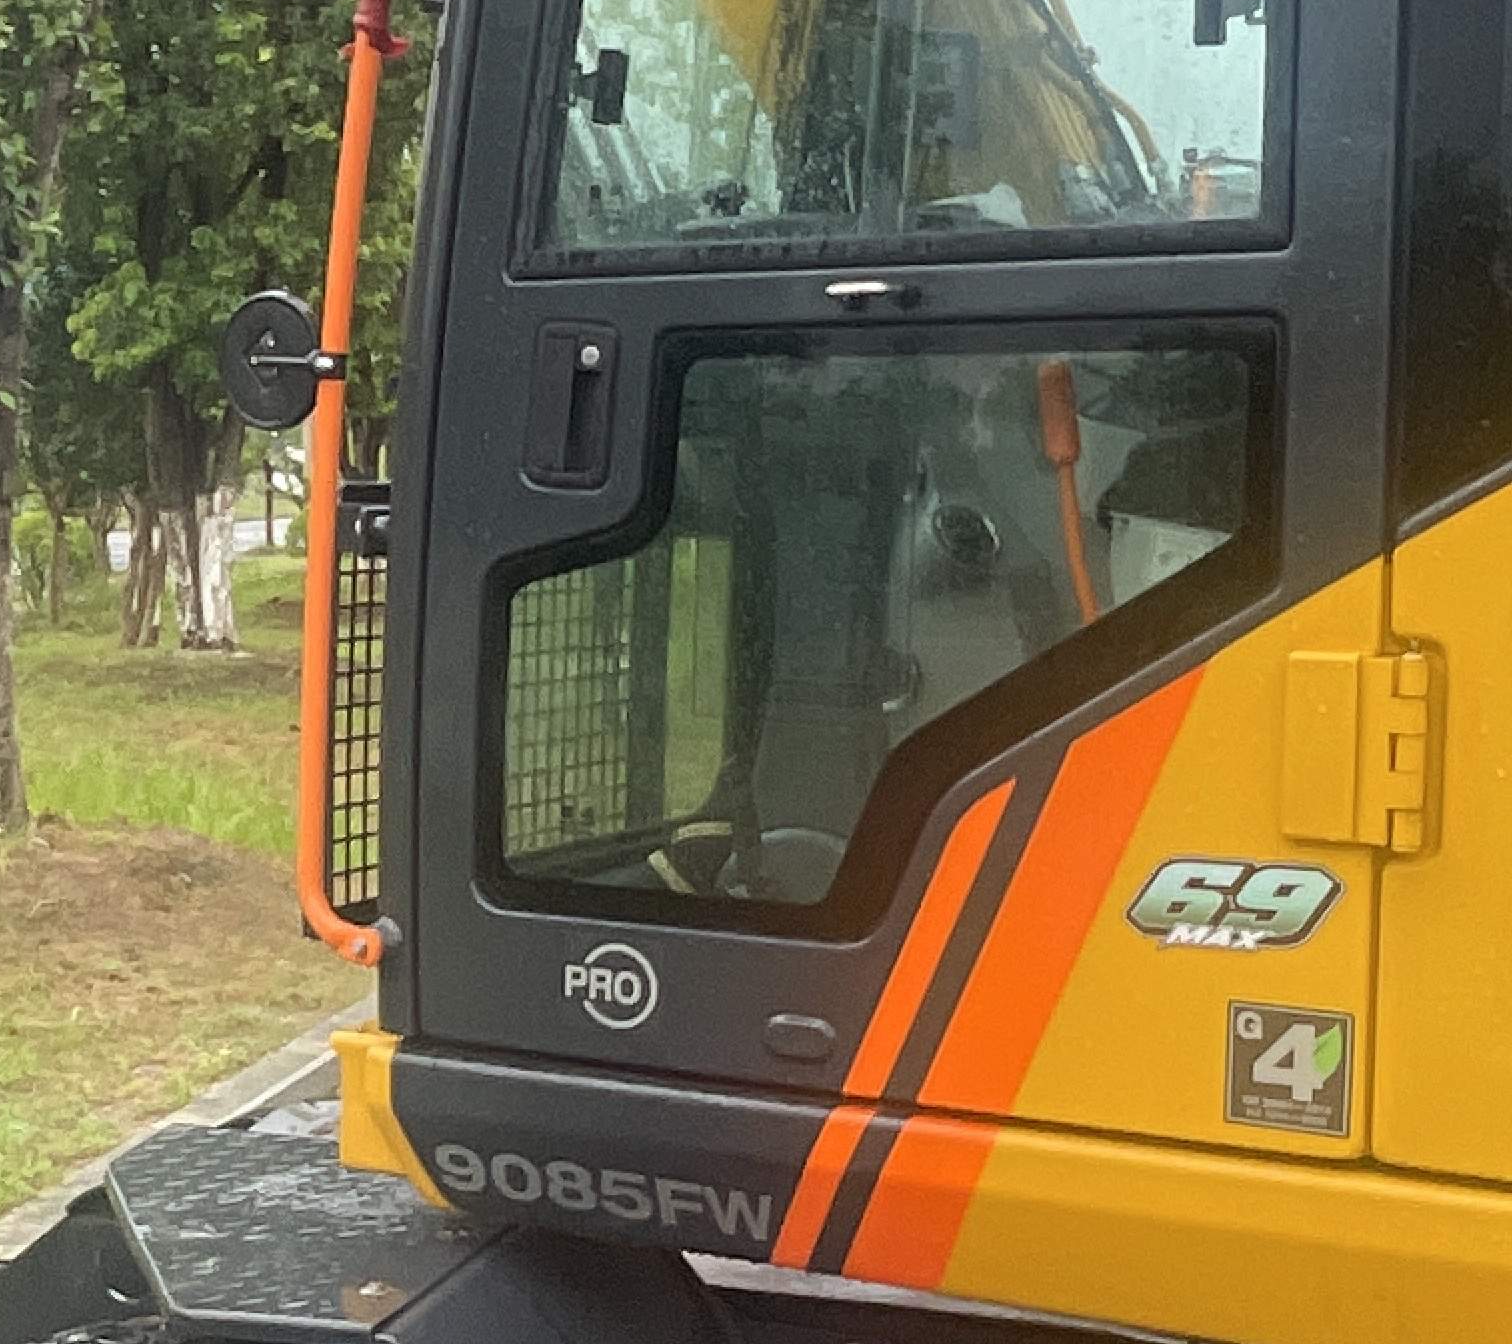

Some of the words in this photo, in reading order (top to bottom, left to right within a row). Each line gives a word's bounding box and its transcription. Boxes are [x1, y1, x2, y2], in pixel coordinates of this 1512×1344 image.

[1128, 860, 1337, 940] 69
[1166, 923, 1265, 950] MAX
[564, 964, 641, 1006] PRO
[1252, 1023, 1324, 1102] 4
[434, 1143, 773, 1242] 9085FW
